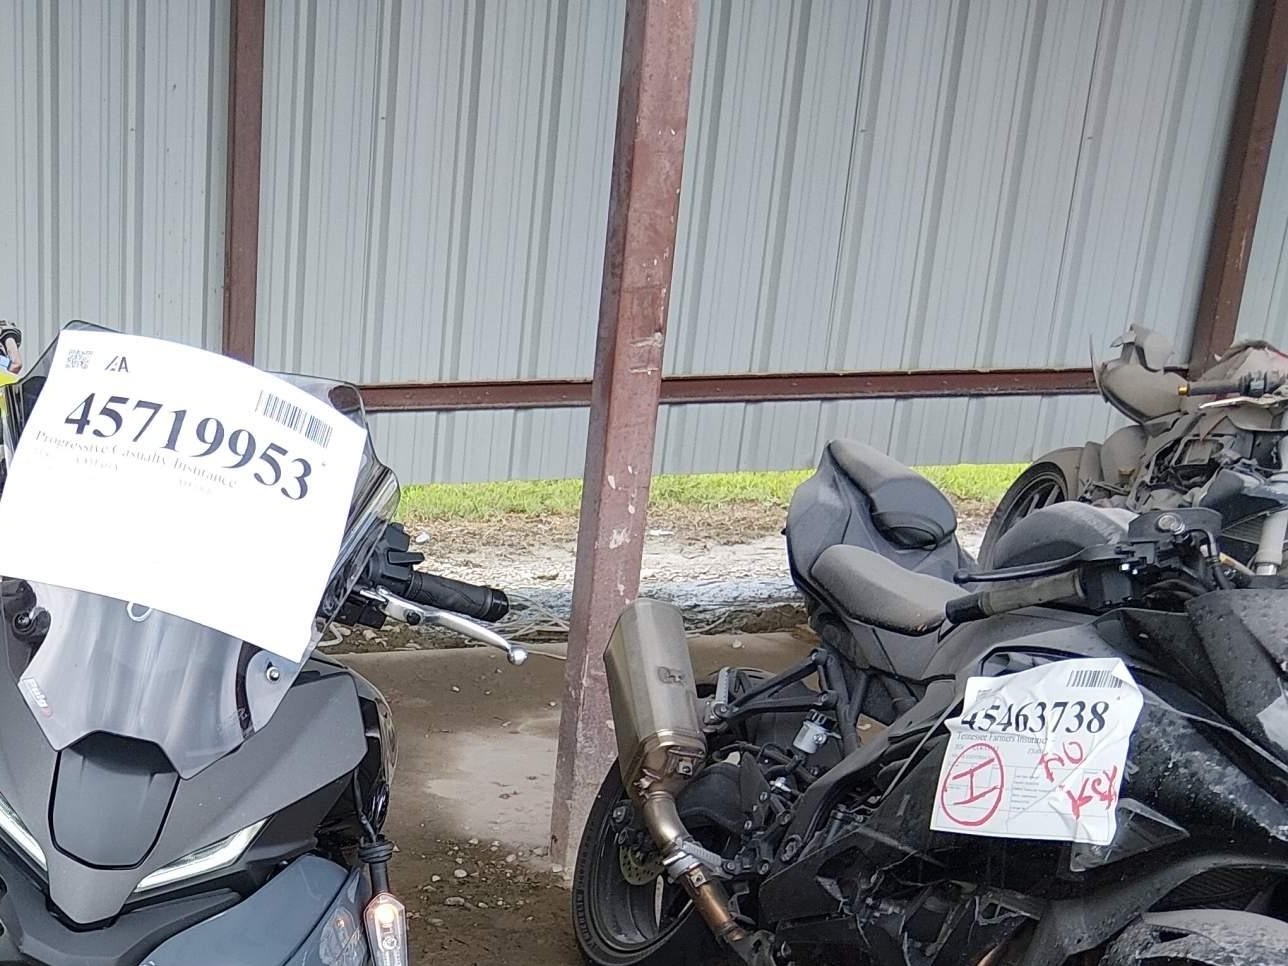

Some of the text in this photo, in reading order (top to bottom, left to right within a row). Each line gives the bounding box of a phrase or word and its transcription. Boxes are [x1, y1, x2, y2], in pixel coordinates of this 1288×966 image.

[35, 430, 109, 455] Progressive
[65, 392, 312, 501] 45719953
[961, 700, 1110, 734] 45463738
